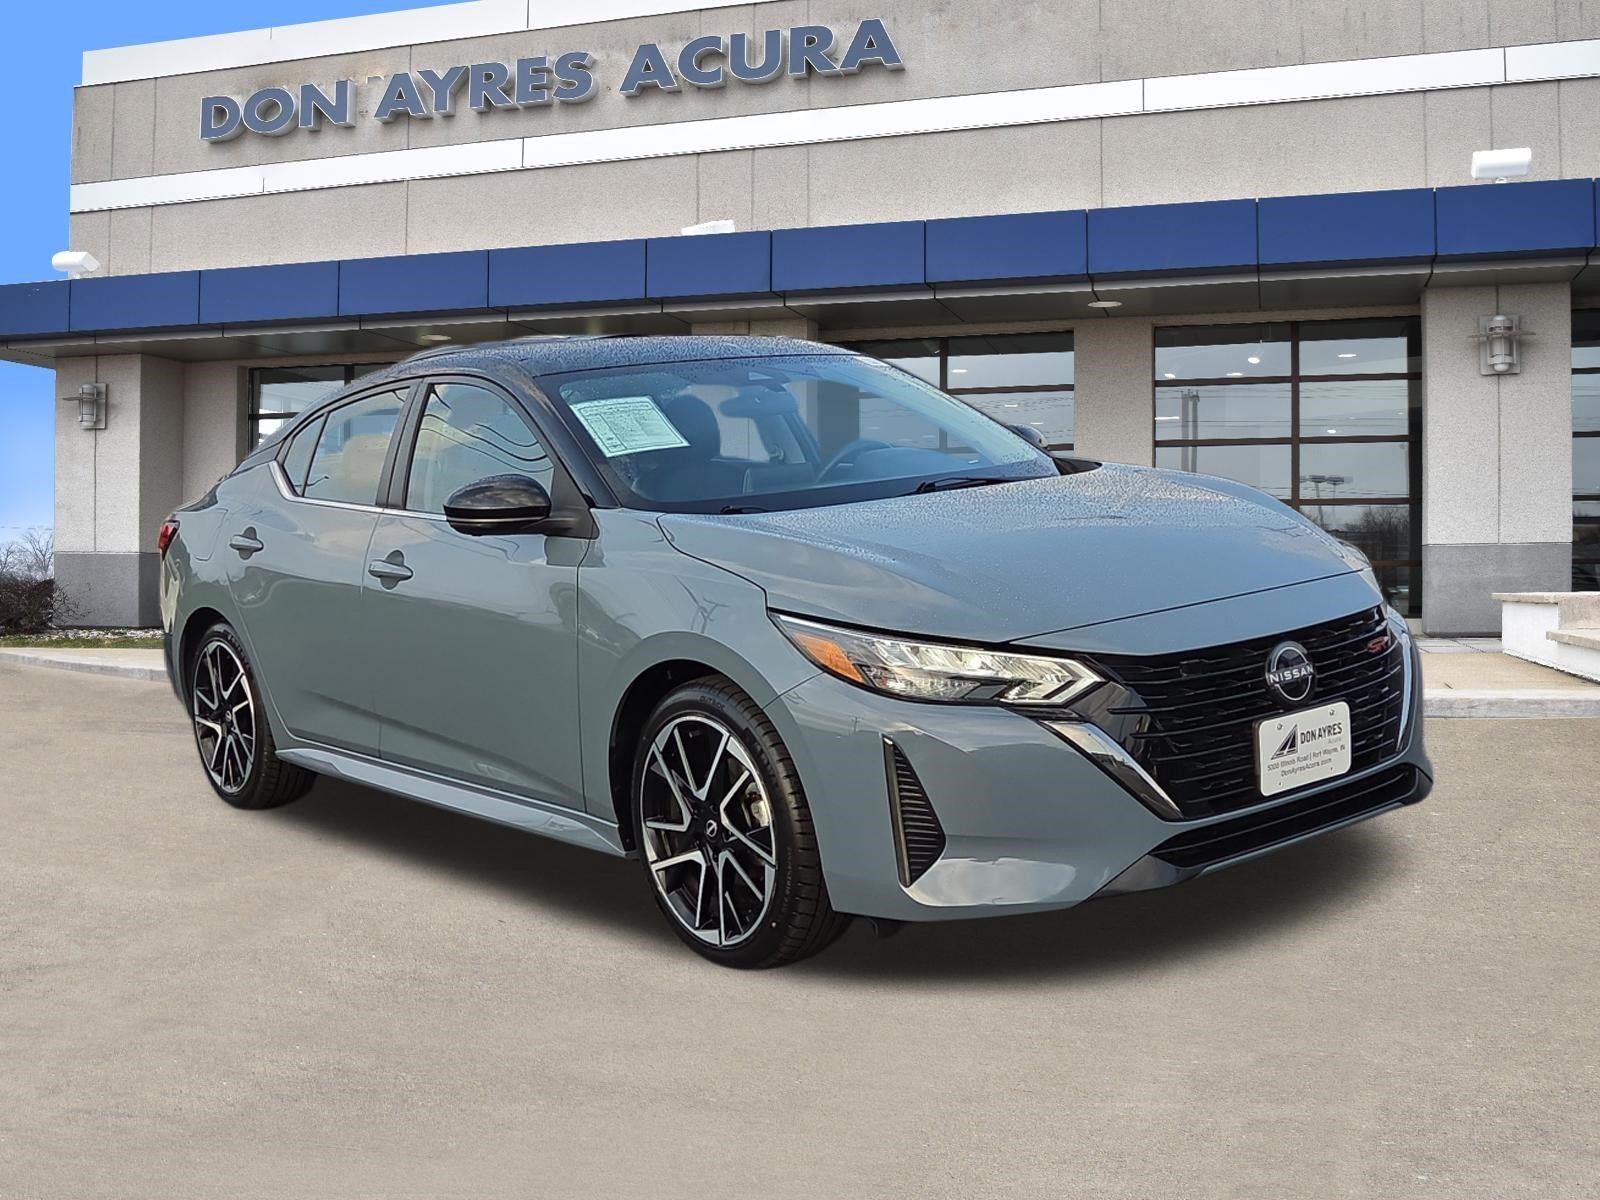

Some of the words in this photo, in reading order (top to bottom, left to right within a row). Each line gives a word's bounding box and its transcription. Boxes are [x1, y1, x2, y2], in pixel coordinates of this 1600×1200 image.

[200, 78, 355, 143] DON
[374, 51, 600, 124] AYRES
[618, 18, 906, 98] ACURA
[1269, 665, 1314, 683] NISSAN
[1300, 729, 1317, 744] DON
[1317, 722, 1343, 740] AYRES
